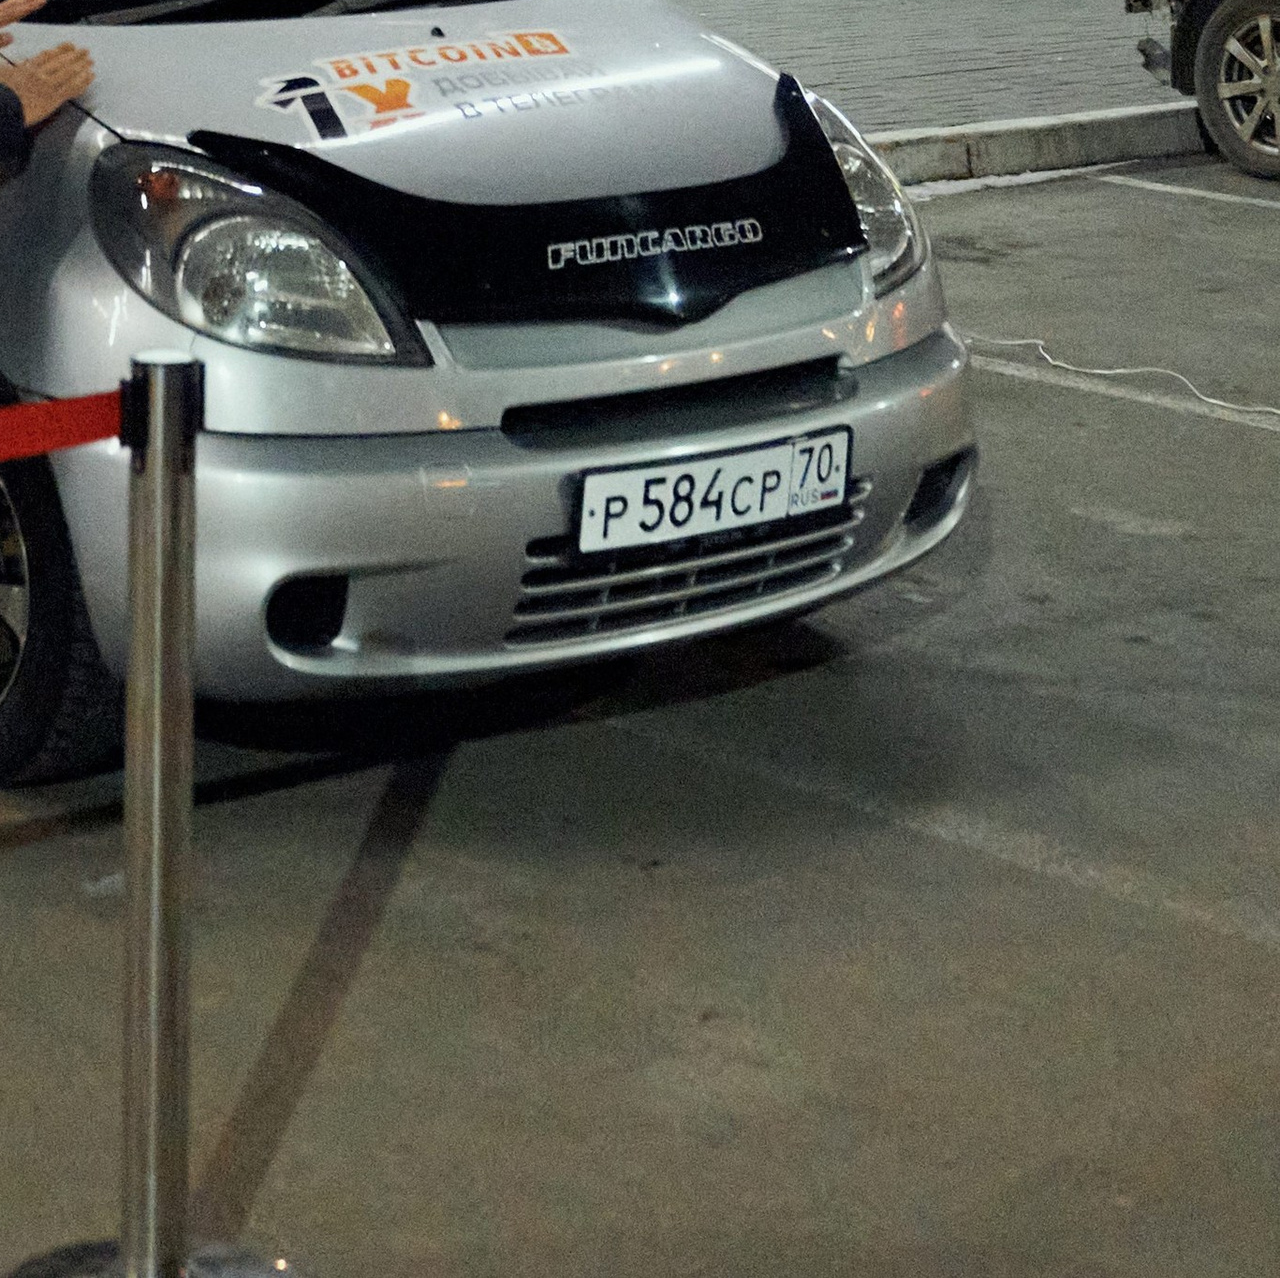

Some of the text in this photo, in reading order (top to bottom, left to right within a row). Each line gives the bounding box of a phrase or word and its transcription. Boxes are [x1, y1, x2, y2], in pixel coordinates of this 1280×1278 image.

[328, 37, 522, 80] BITCOIN
[798, 443, 835, 490] 70
[791, 489, 819, 508] RUS
